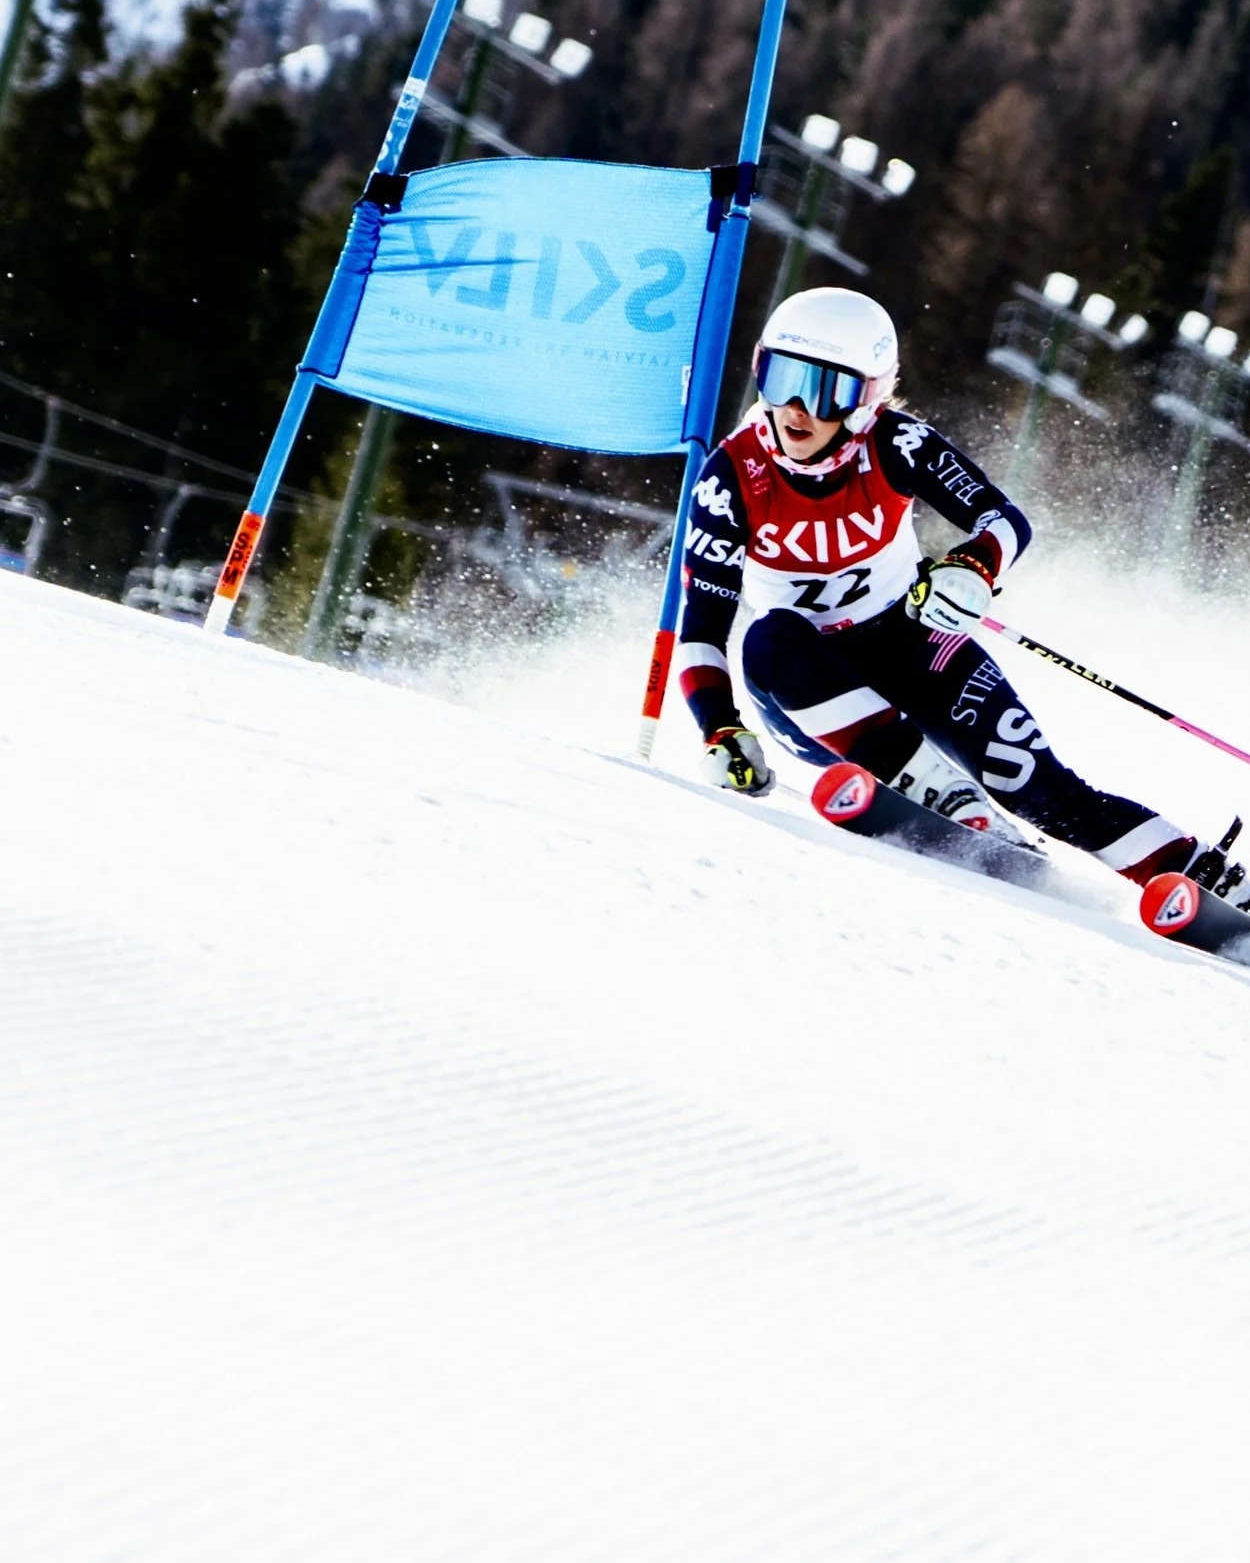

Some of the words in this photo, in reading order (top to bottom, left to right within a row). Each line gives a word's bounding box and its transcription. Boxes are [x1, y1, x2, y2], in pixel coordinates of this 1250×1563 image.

[927, 451, 985, 506] STIFEL
[685, 517, 746, 571] VISA
[789, 568, 871, 613] 22
[1070, 662, 1116, 690] LEKI
